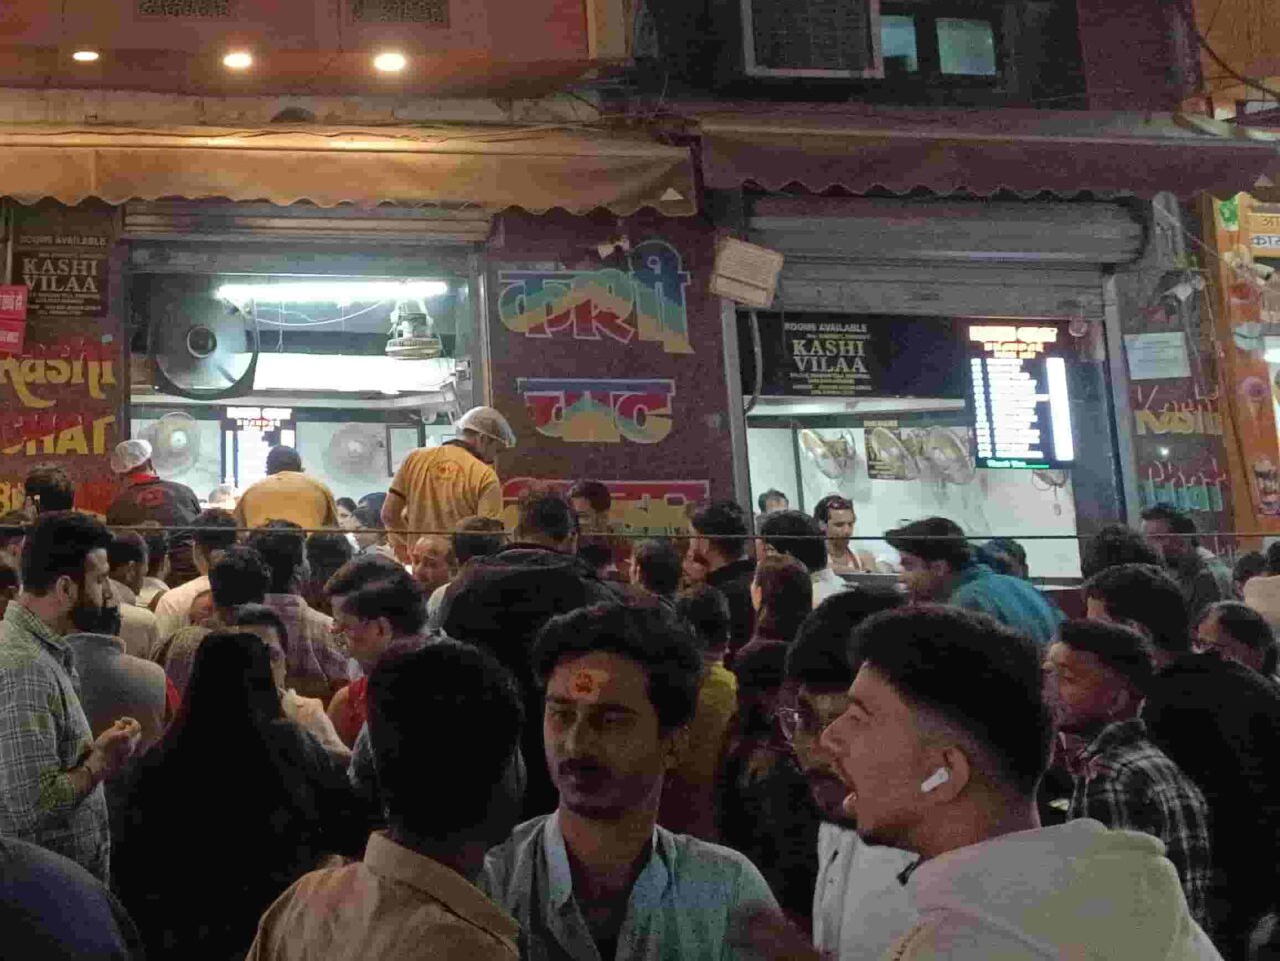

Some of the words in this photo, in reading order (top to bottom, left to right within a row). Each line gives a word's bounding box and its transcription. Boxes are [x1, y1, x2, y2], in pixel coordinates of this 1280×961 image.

[22, 258, 98, 276] KASHI
[22, 274, 98, 293] VILAA
[792, 339, 866, 357] KASHI
[793, 356, 869, 373] VILAA
